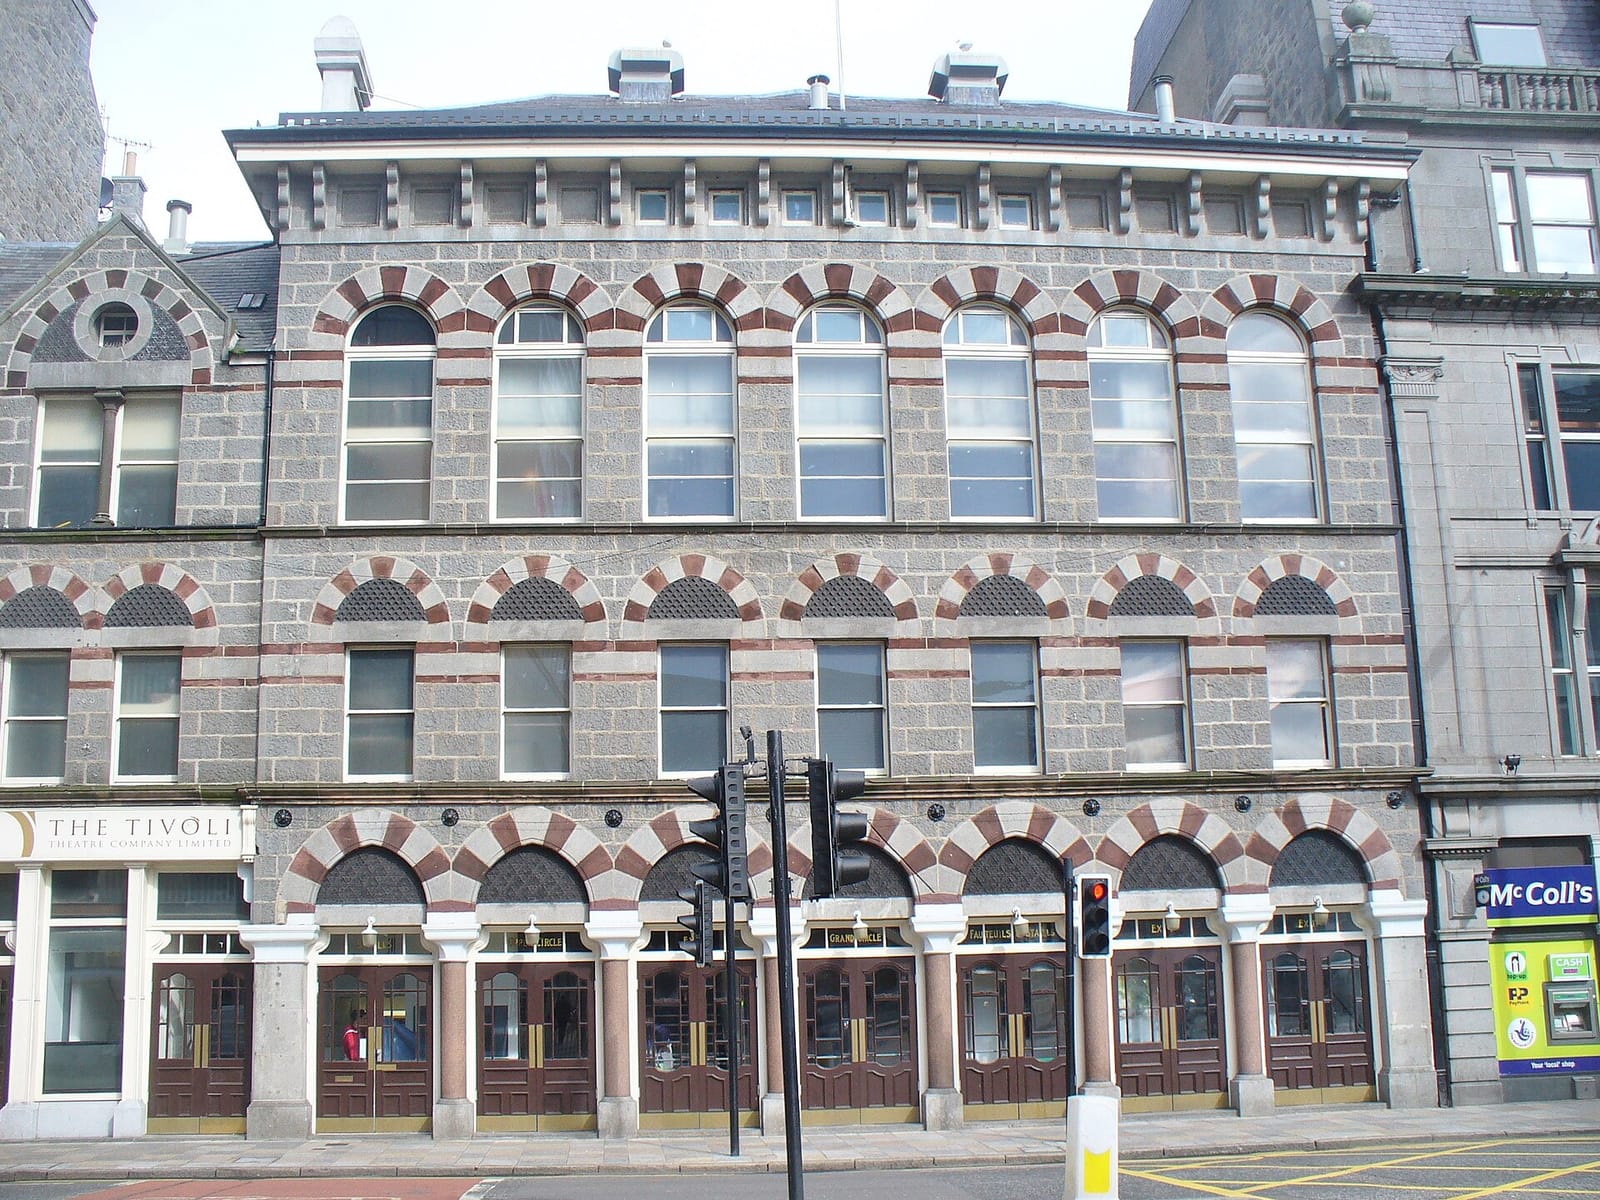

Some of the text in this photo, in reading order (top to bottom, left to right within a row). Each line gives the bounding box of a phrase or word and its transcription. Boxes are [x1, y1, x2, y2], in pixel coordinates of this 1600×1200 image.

[49, 816, 230, 836] THE TIVOLI
[49, 839, 231, 849] THEATRE COMPANY LIMITED
[1556, 958, 1583, 967] CASH
